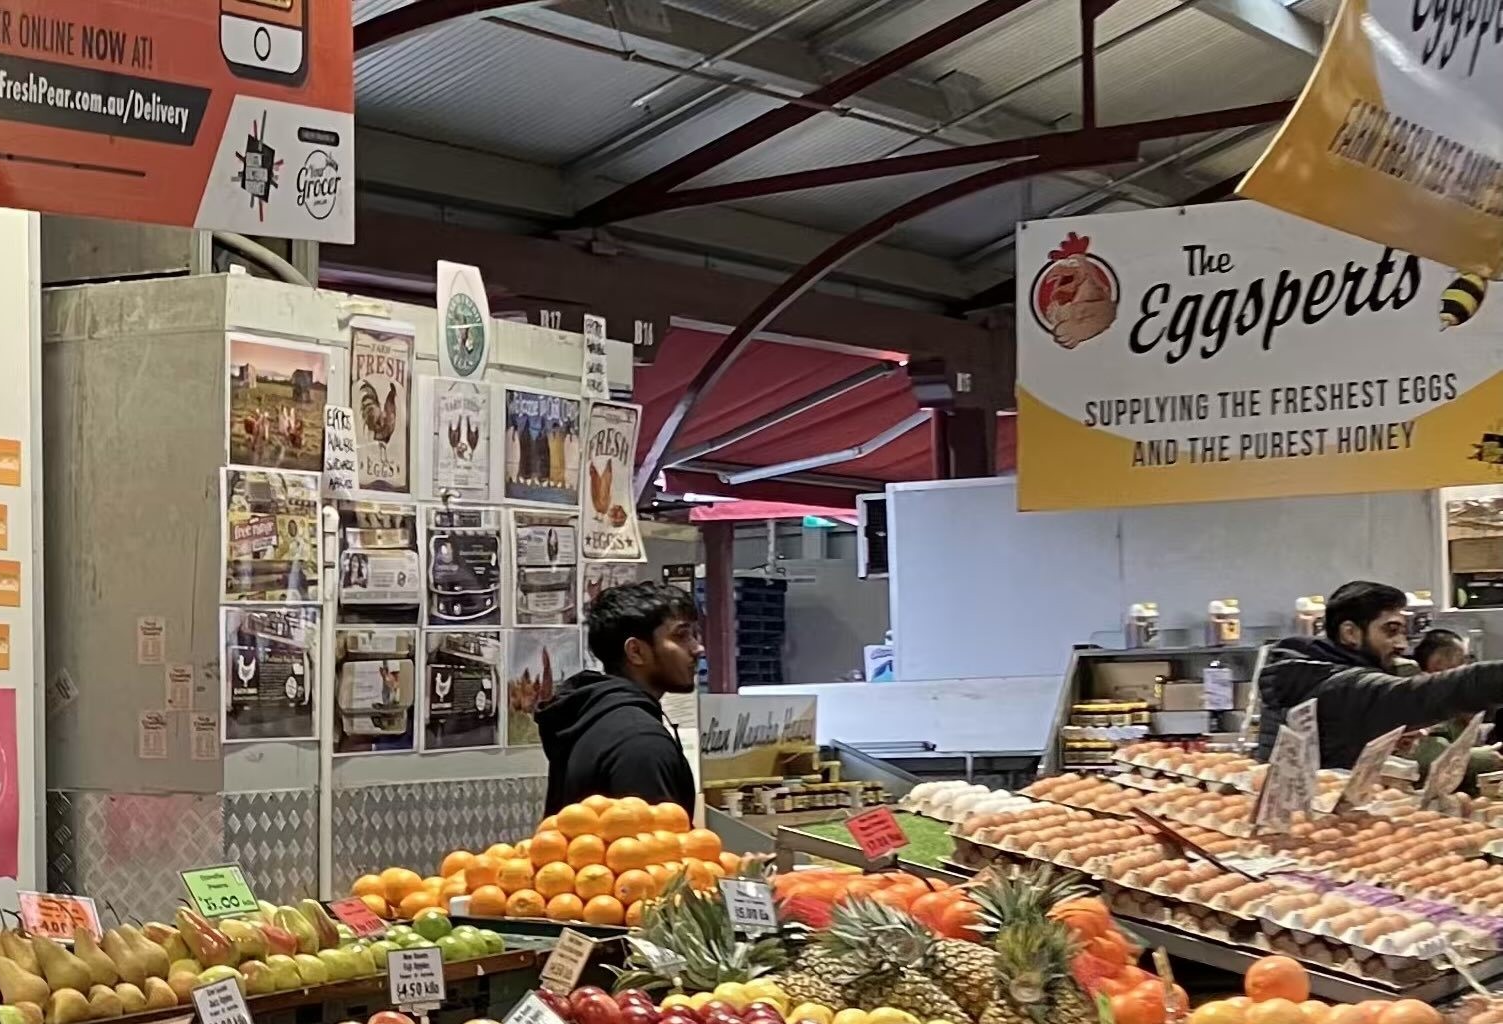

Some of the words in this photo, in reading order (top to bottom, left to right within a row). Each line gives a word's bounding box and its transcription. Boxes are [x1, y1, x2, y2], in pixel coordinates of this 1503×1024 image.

[20, 17, 74, 56] ONLINE
[82, 27, 126, 62] NOW
[132, 37, 153, 69] AT!
[1183, 245, 1233, 276] The
[1129, 247, 1422, 364] Eggsperts
[356, 354, 406, 387] FRESH
[1084, 394, 1209, 428] SUPPLYING
[1217, 391, 1260, 417] THE
[1271, 380, 1387, 414] FRESHEST
[1398, 373, 1457, 404] EGGS
[1132, 440, 1177, 467] AND
[1189, 436, 1231, 463] THE
[1240, 428, 1328, 458] PUREST
[1336, 421, 1415, 452] HONEY
[592, 532, 624, 550] EGGS
